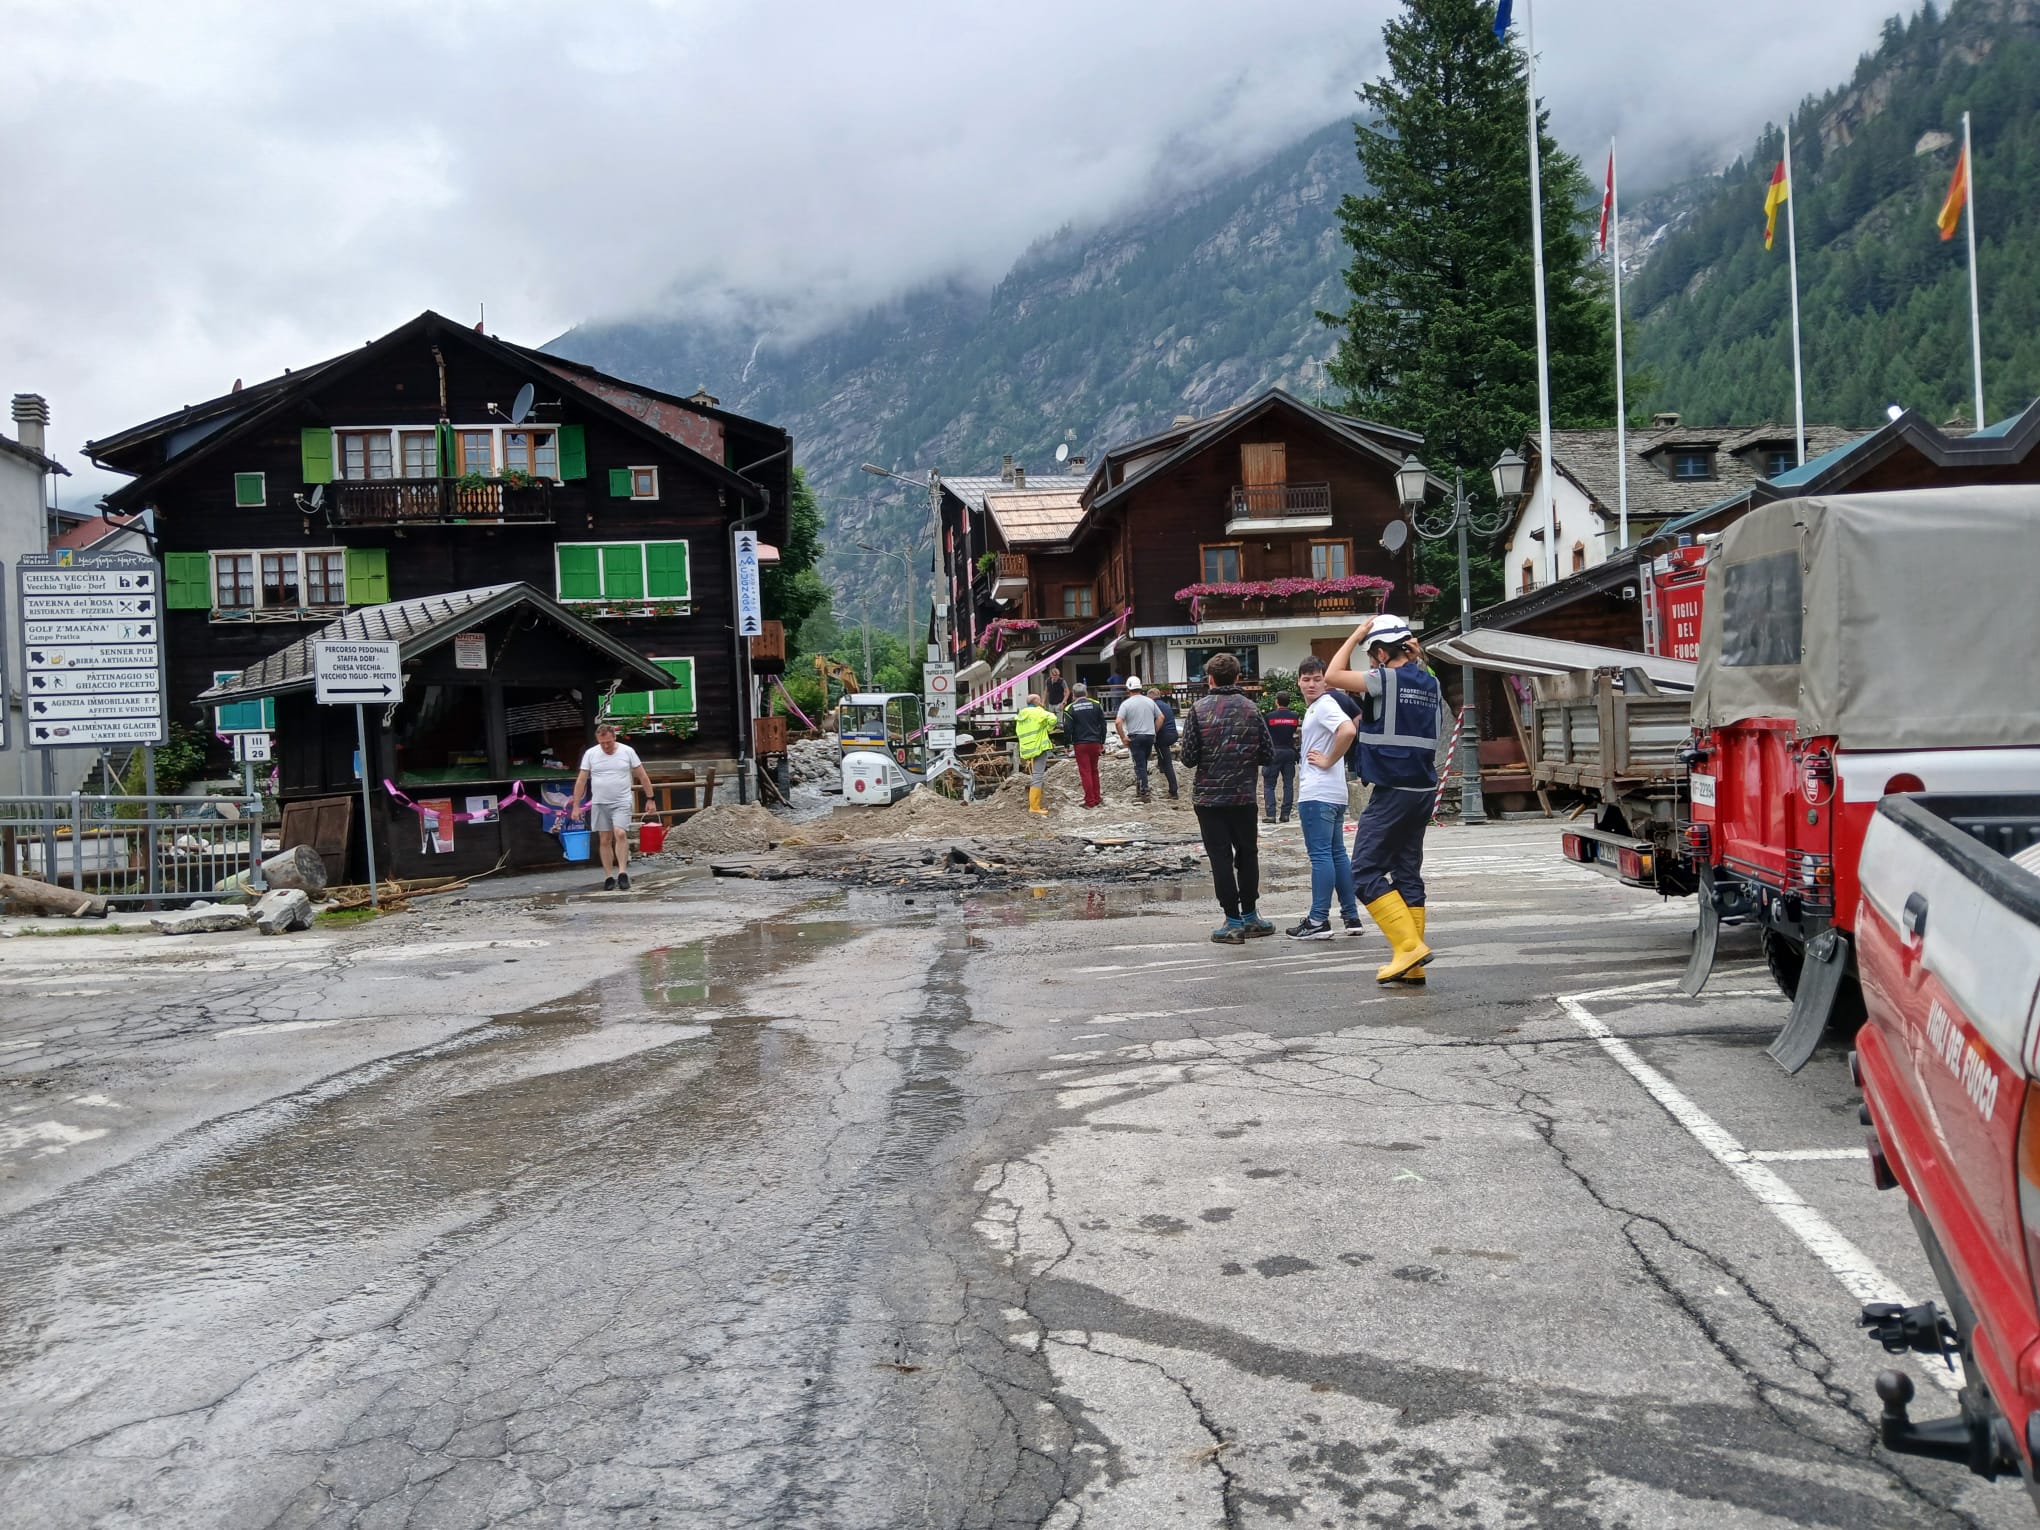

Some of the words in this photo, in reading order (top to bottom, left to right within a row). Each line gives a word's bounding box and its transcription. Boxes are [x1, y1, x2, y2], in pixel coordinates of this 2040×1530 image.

[1672, 601, 1698, 619] VIGILI
[1228, 634, 1276, 643] FERRAMENTA
[1678, 622, 1694, 638] DEL
[1674, 642, 1700, 659] FUOCO
[1927, 998, 1950, 1056] VIGILI
[1946, 1024, 1966, 1080] DEL
[1962, 1045, 1998, 1122] FUOCO
